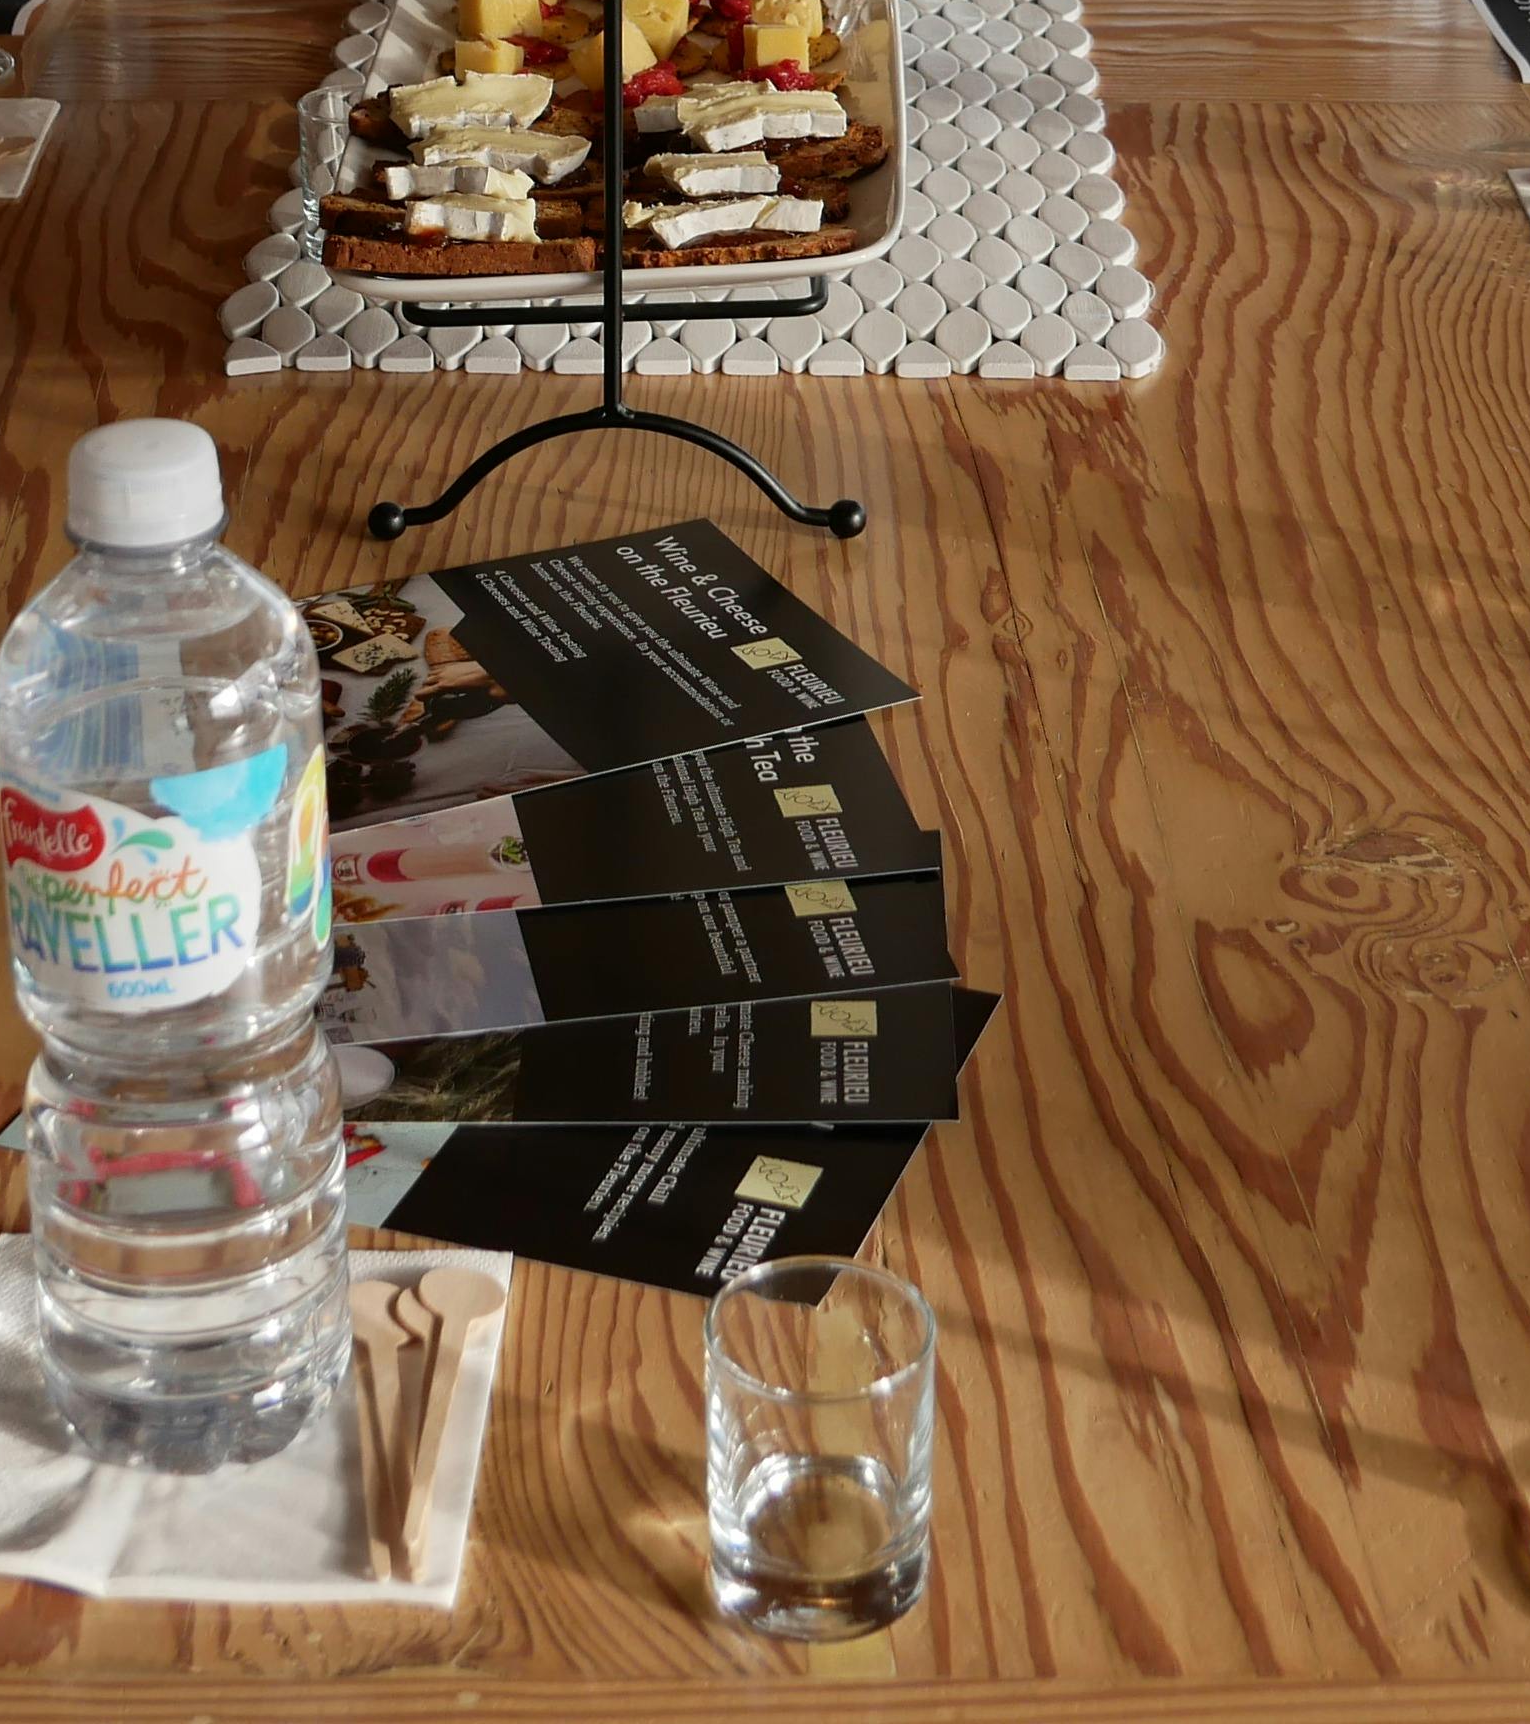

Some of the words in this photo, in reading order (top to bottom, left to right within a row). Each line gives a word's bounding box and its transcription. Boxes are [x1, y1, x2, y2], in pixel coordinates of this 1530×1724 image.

[616, 546, 634, 566] on
[636, 565, 669, 588] the
[659, 587, 729, 640] Fleurieu
[653, 535, 698, 575] Wine
[691, 568, 718, 586] &
[706, 585, 768, 637] Cheese
[766, 669, 795, 688] FOOD
[783, 663, 846, 705] FLEURIEU
[788, 736, 819, 764] the
[750, 750, 782, 783] Tea
[795, 820, 817, 844] FOOD
[815, 817, 860, 869] FLEURIEU
[804, 842, 821, 851] &
[809, 850, 830, 872] WINE
[41, 854, 208, 916] perfect
[9, 883, 243, 973] RAVELLER
[808, 919, 831, 947] FOOD
[818, 946, 835, 955] &
[829, 916, 875, 976] FLEURIEU
[822, 953, 846, 980] WINE
[820, 1041, 837, 1069] FOOD
[820, 1070, 837, 1078] &
[843, 1041, 870, 1103] FLEURIEU
[820, 1077, 838, 1104] WINE
[722, 1202, 755, 1235] FOOD
[714, 1234, 733, 1248] &
[720, 1207, 786, 1281] FLEURIEU
[694, 1247, 727, 1276] WINE
